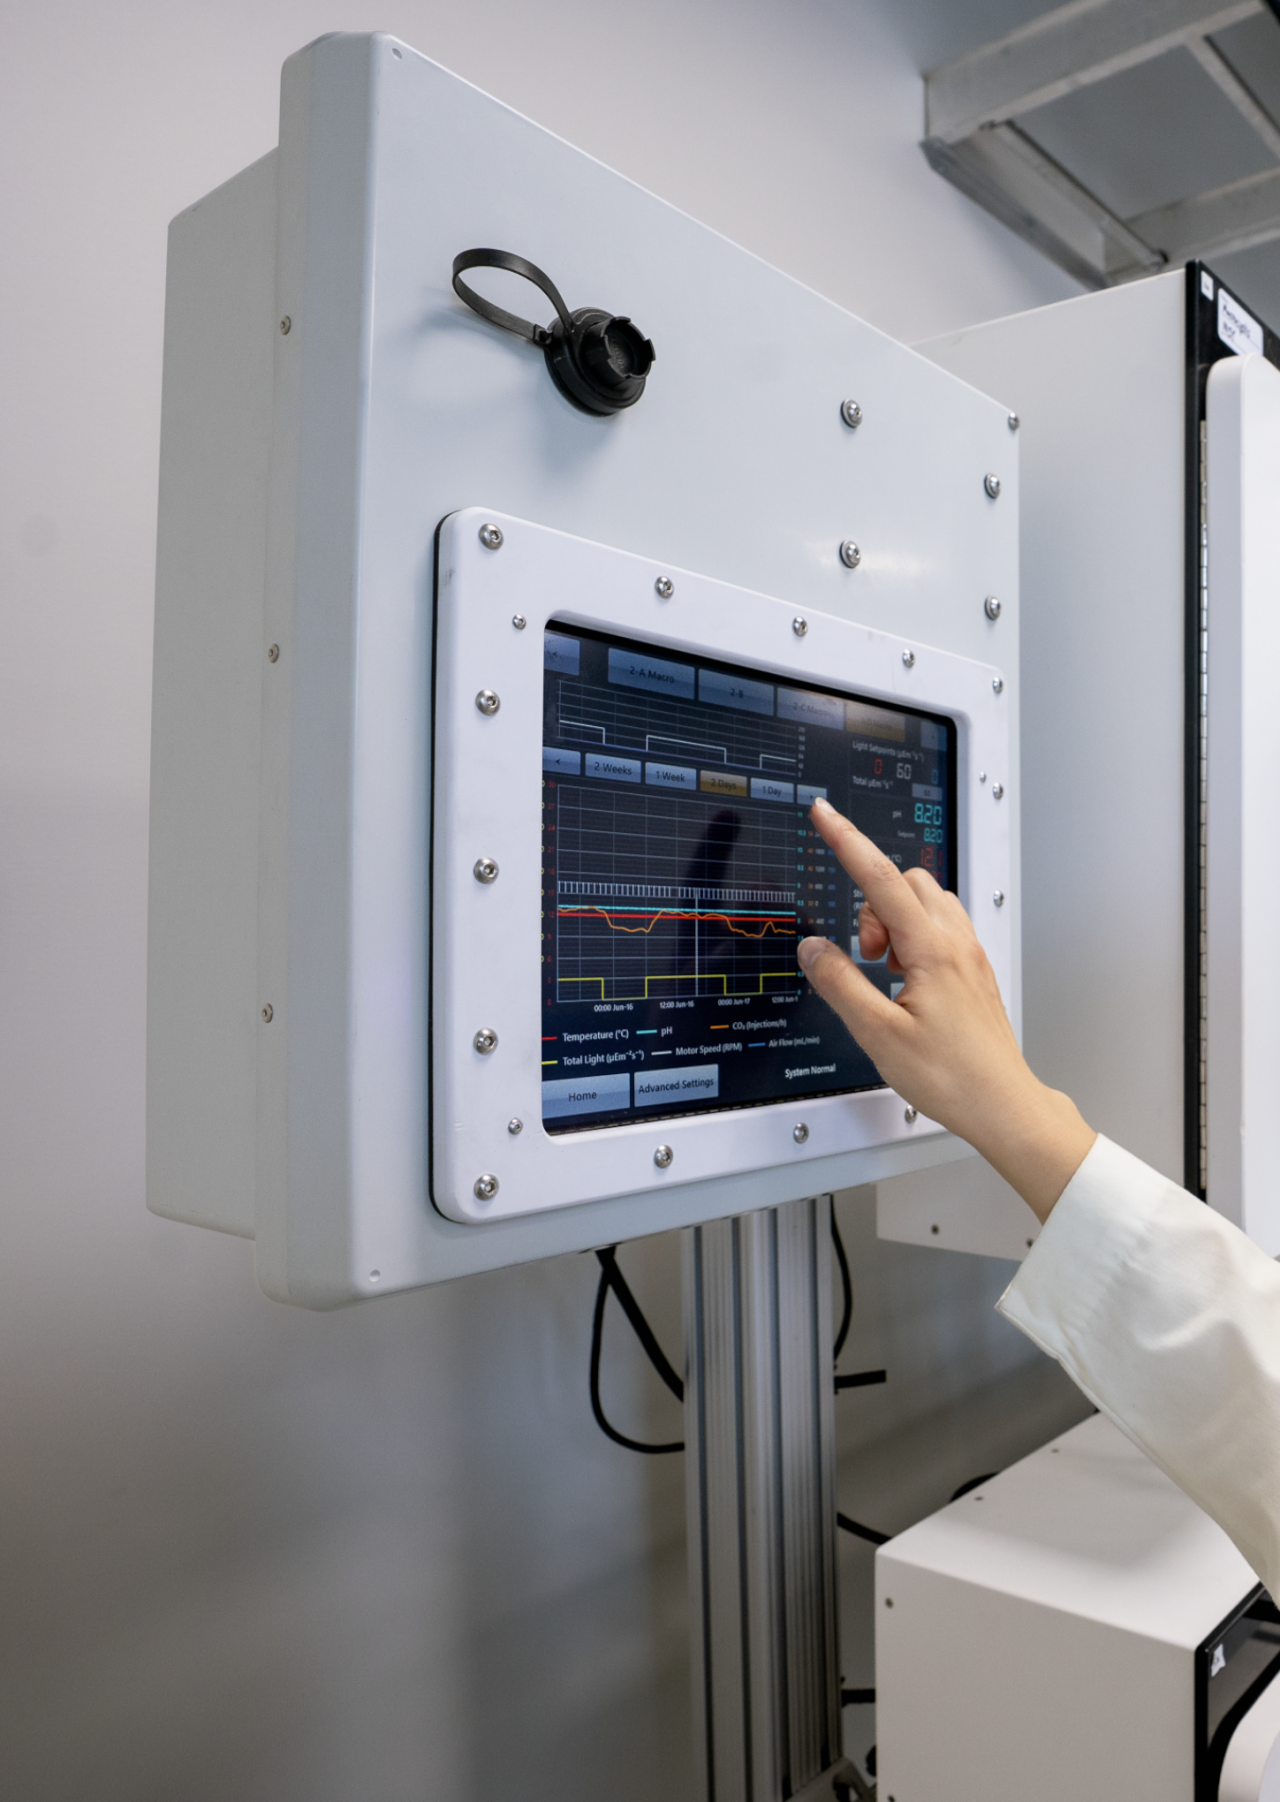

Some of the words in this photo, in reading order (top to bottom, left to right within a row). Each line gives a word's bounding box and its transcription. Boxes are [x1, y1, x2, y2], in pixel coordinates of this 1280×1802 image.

[629, 665, 645, 678] 2-A
[648, 669, 675, 684] Macro
[594, 761, 601, 772] 2
[603, 763, 633, 776] Weeks
[896, 762, 912, 780] 60
[656, 770, 660, 780] 1
[662, 771, 686, 783] Week
[852, 775, 868, 787] Total
[711, 778, 717, 788] 2
[718, 779, 737, 791] Days
[762, 785, 766, 795] 1
[767, 786, 782, 797] Day
[593, 1004, 612, 1013] 00:00
[613, 1003, 634, 1012] Jun-16
[659, 1001, 675, 1009] 12:00
[675, 1000, 695, 1009] Jun-16
[661, 1026, 673, 1037] pH
[746, 1018, 787, 1032] (Injections/h)
[562, 1030, 614, 1044] Temperature
[615, 1029, 630, 1041] (°C)
[768, 1038, 778, 1048] Air
[778, 1037, 793, 1048] Flow
[675, 1046, 698, 1056] Motor
[699, 1044, 722, 1056] Speed
[722, 1042, 743, 1053] (RPM)
[562, 1055, 583, 1067] Total
[584, 1053, 606, 1067] Light
[784, 1065, 810, 1080] System
[810, 1062, 837, 1075] Normal
[637, 1081, 681, 1095] Advanced
[681, 1077, 715, 1091] Settings
[568, 1090, 598, 1103] Home
